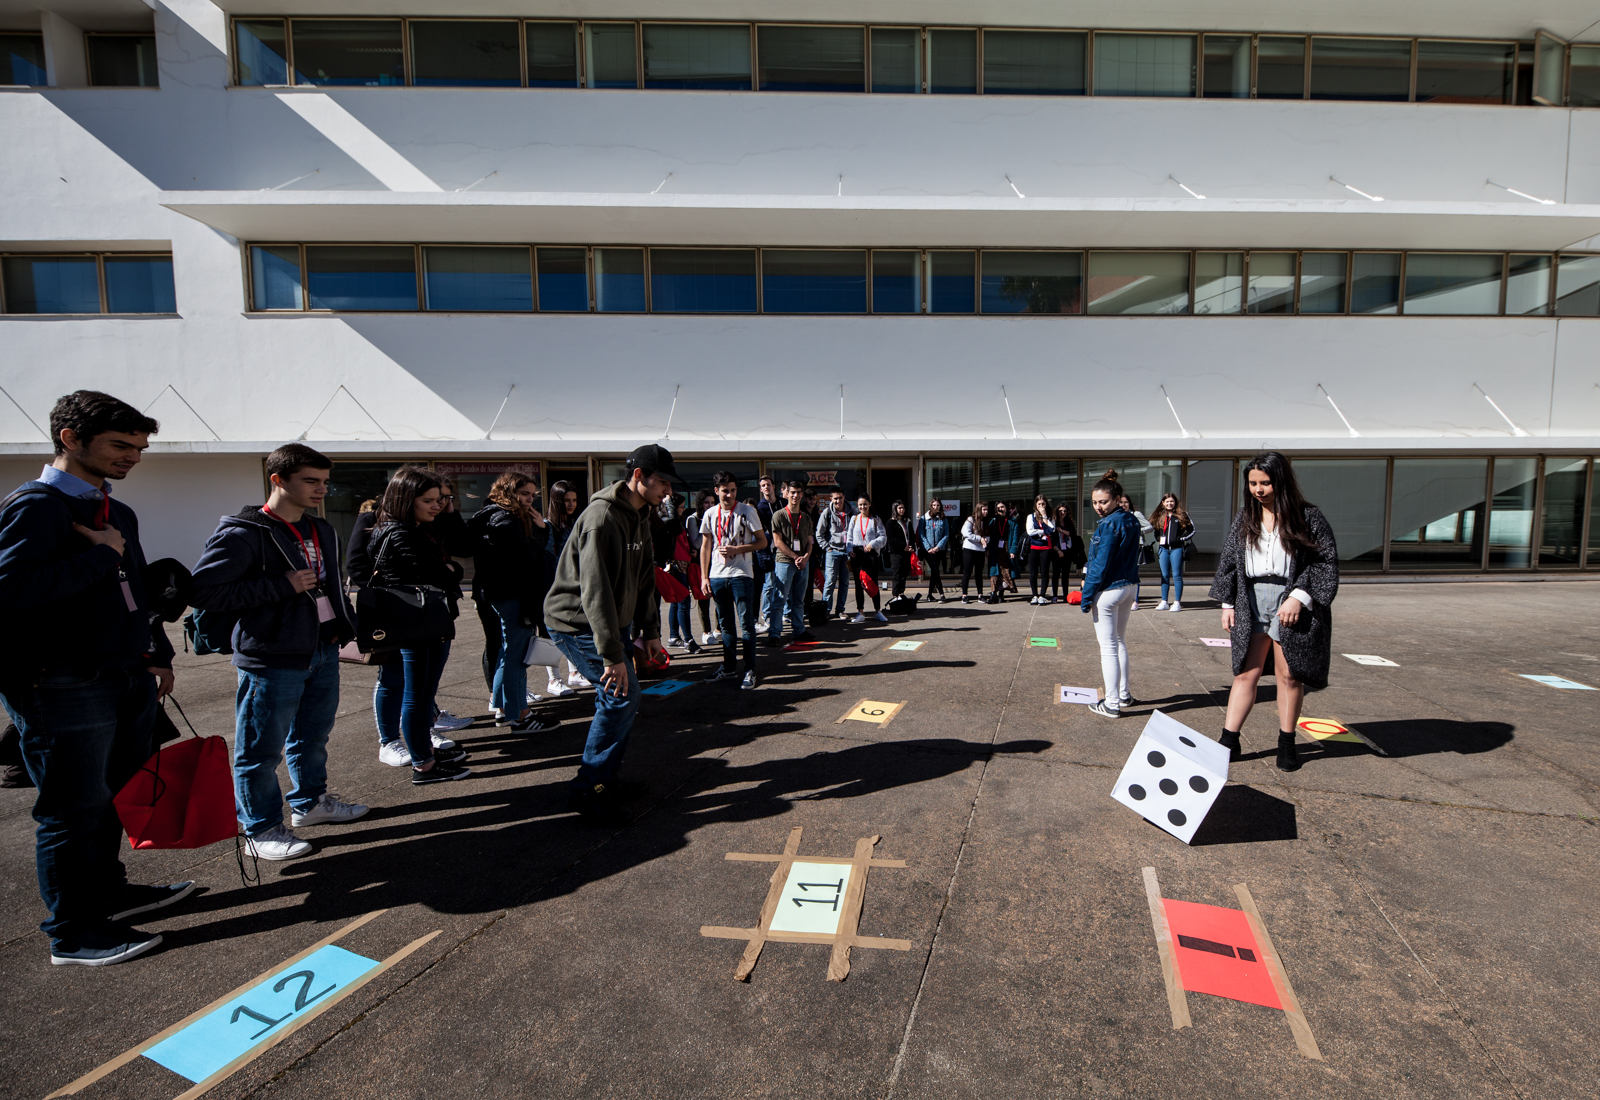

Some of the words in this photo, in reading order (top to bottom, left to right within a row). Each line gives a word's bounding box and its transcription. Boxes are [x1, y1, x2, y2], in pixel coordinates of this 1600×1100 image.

[454, 464, 461, 473] de
[461, 464, 480, 473] Estudos
[480, 464, 487, 473] de
[810, 474, 835, 483] ACE
[861, 707, 885, 716] 6
[792, 878, 844, 912] 11
[229, 969, 337, 1040] 12
